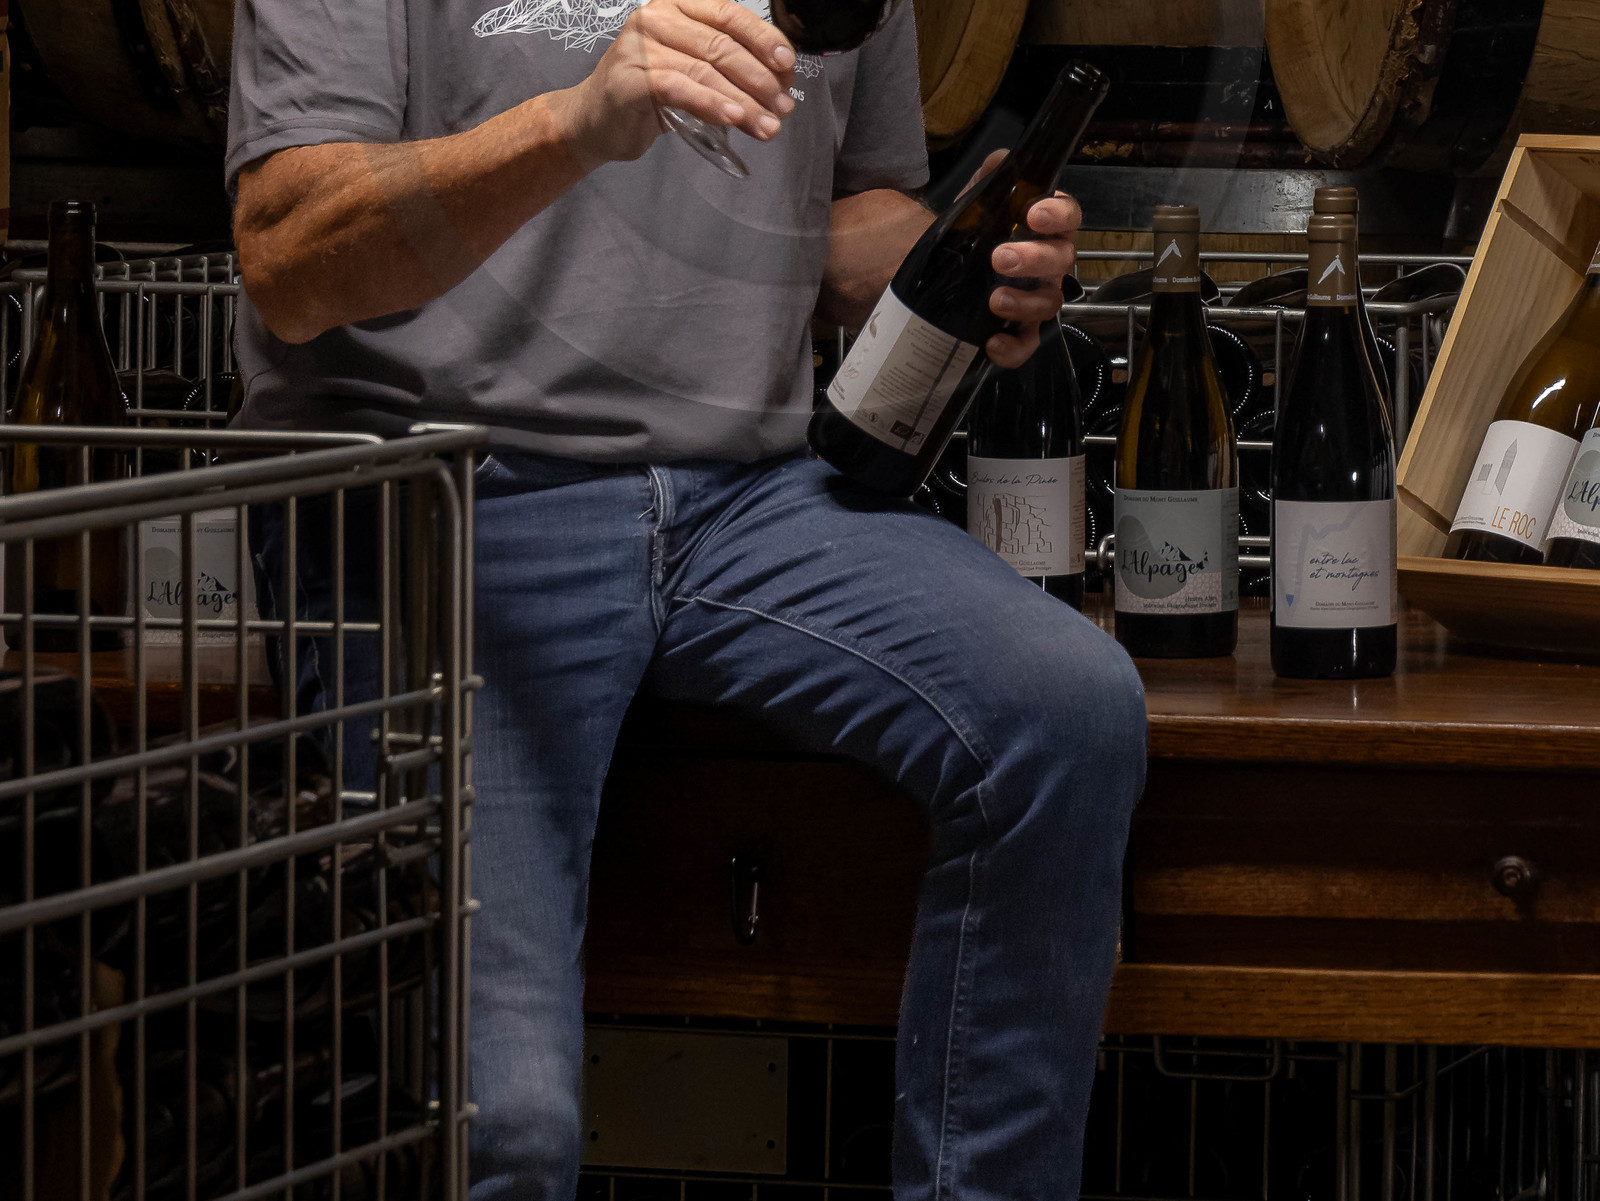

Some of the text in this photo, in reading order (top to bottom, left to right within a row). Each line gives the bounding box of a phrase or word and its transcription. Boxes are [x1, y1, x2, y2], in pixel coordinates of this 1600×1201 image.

[997, 473, 1010, 484] de
[1011, 474, 1021, 484] la
[1491, 506, 1537, 539] LE ROC
[1121, 549, 1198, 583] L'Alpage
[1309, 551, 1359, 565] entre lac
[1309, 566, 1380, 591] et montagnes
[146, 579, 234, 613] L'Alage
